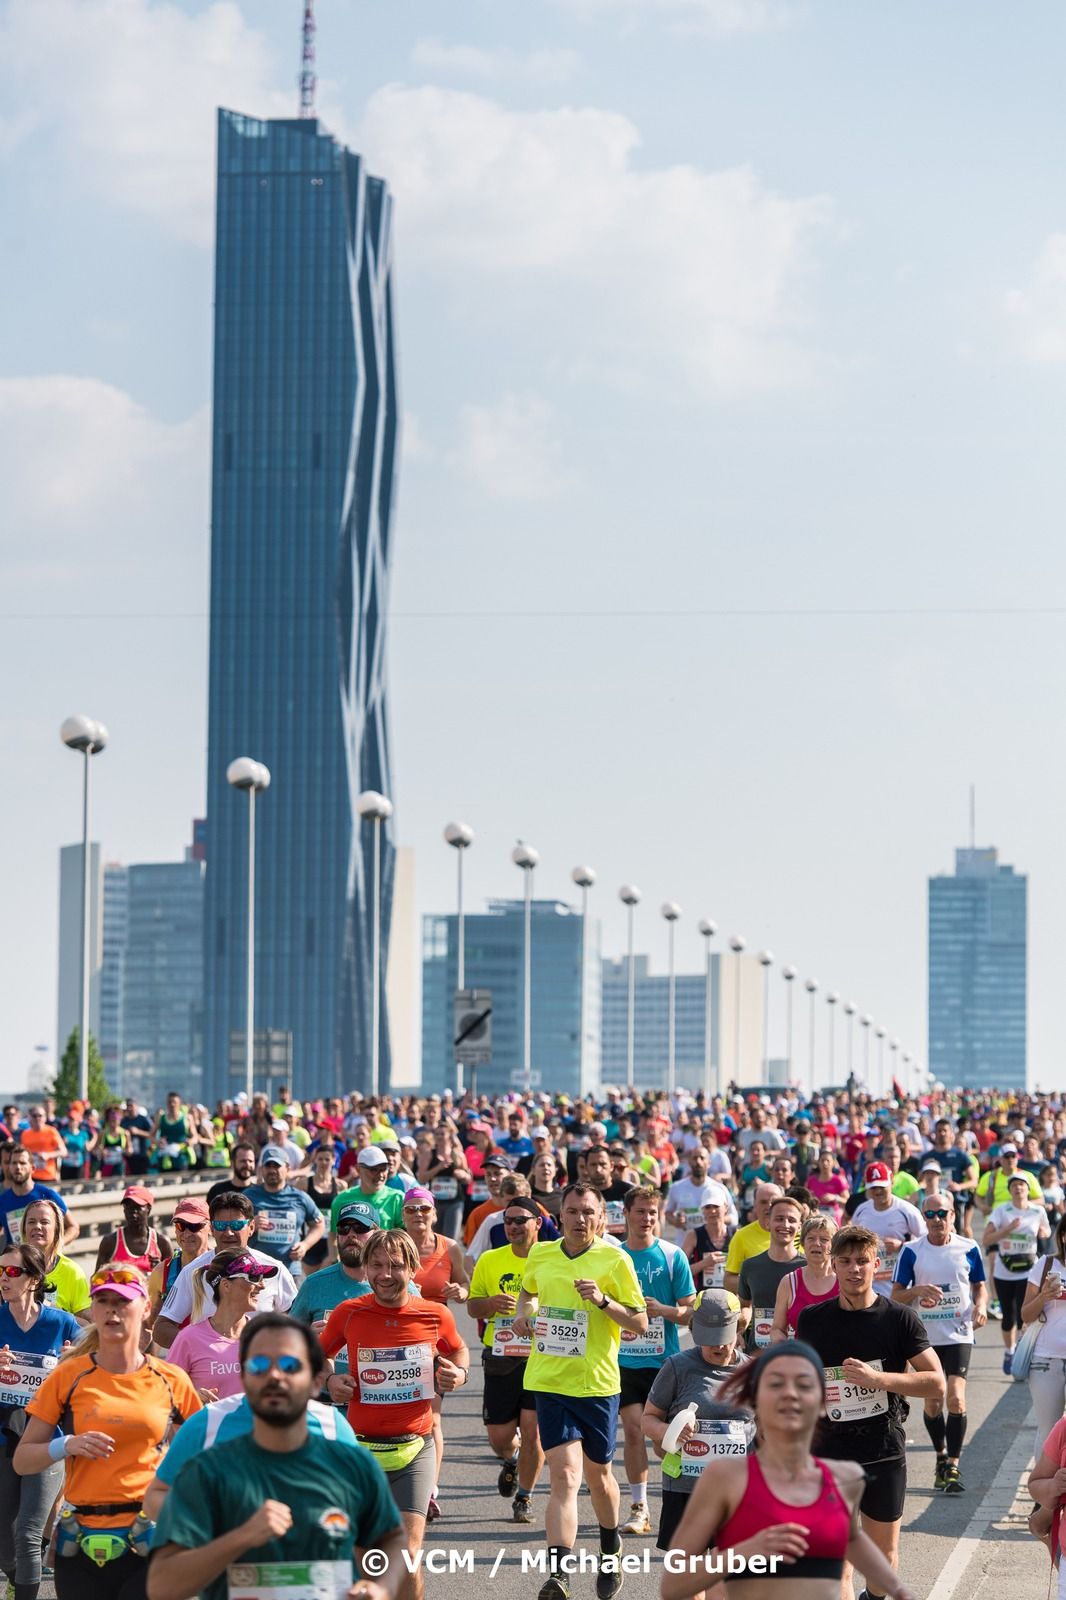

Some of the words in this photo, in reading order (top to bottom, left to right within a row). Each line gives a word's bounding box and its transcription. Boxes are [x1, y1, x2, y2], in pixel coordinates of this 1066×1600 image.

[872, 1168, 881, 1178] A
[506, 1283, 522, 1293] WOR
[551, 1325, 579, 1338] 3529
[579, 1331, 586, 1339] A
[620, 1347, 657, 1355] SPARKASSE
[210, 1361, 241, 1375] Favo
[387, 1367, 422, 1381] 23598
[21, 1374, 46, 1387] 209
[362, 1372, 385, 1381] Hervis
[1, 1392, 31, 1405] ERSTE
[363, 1391, 412, 1402] SPARKASSE
[857, 1394, 875, 1402] Daniel
[685, 1442, 708, 1454] Hervis
[711, 1443, 746, 1455] 13725
